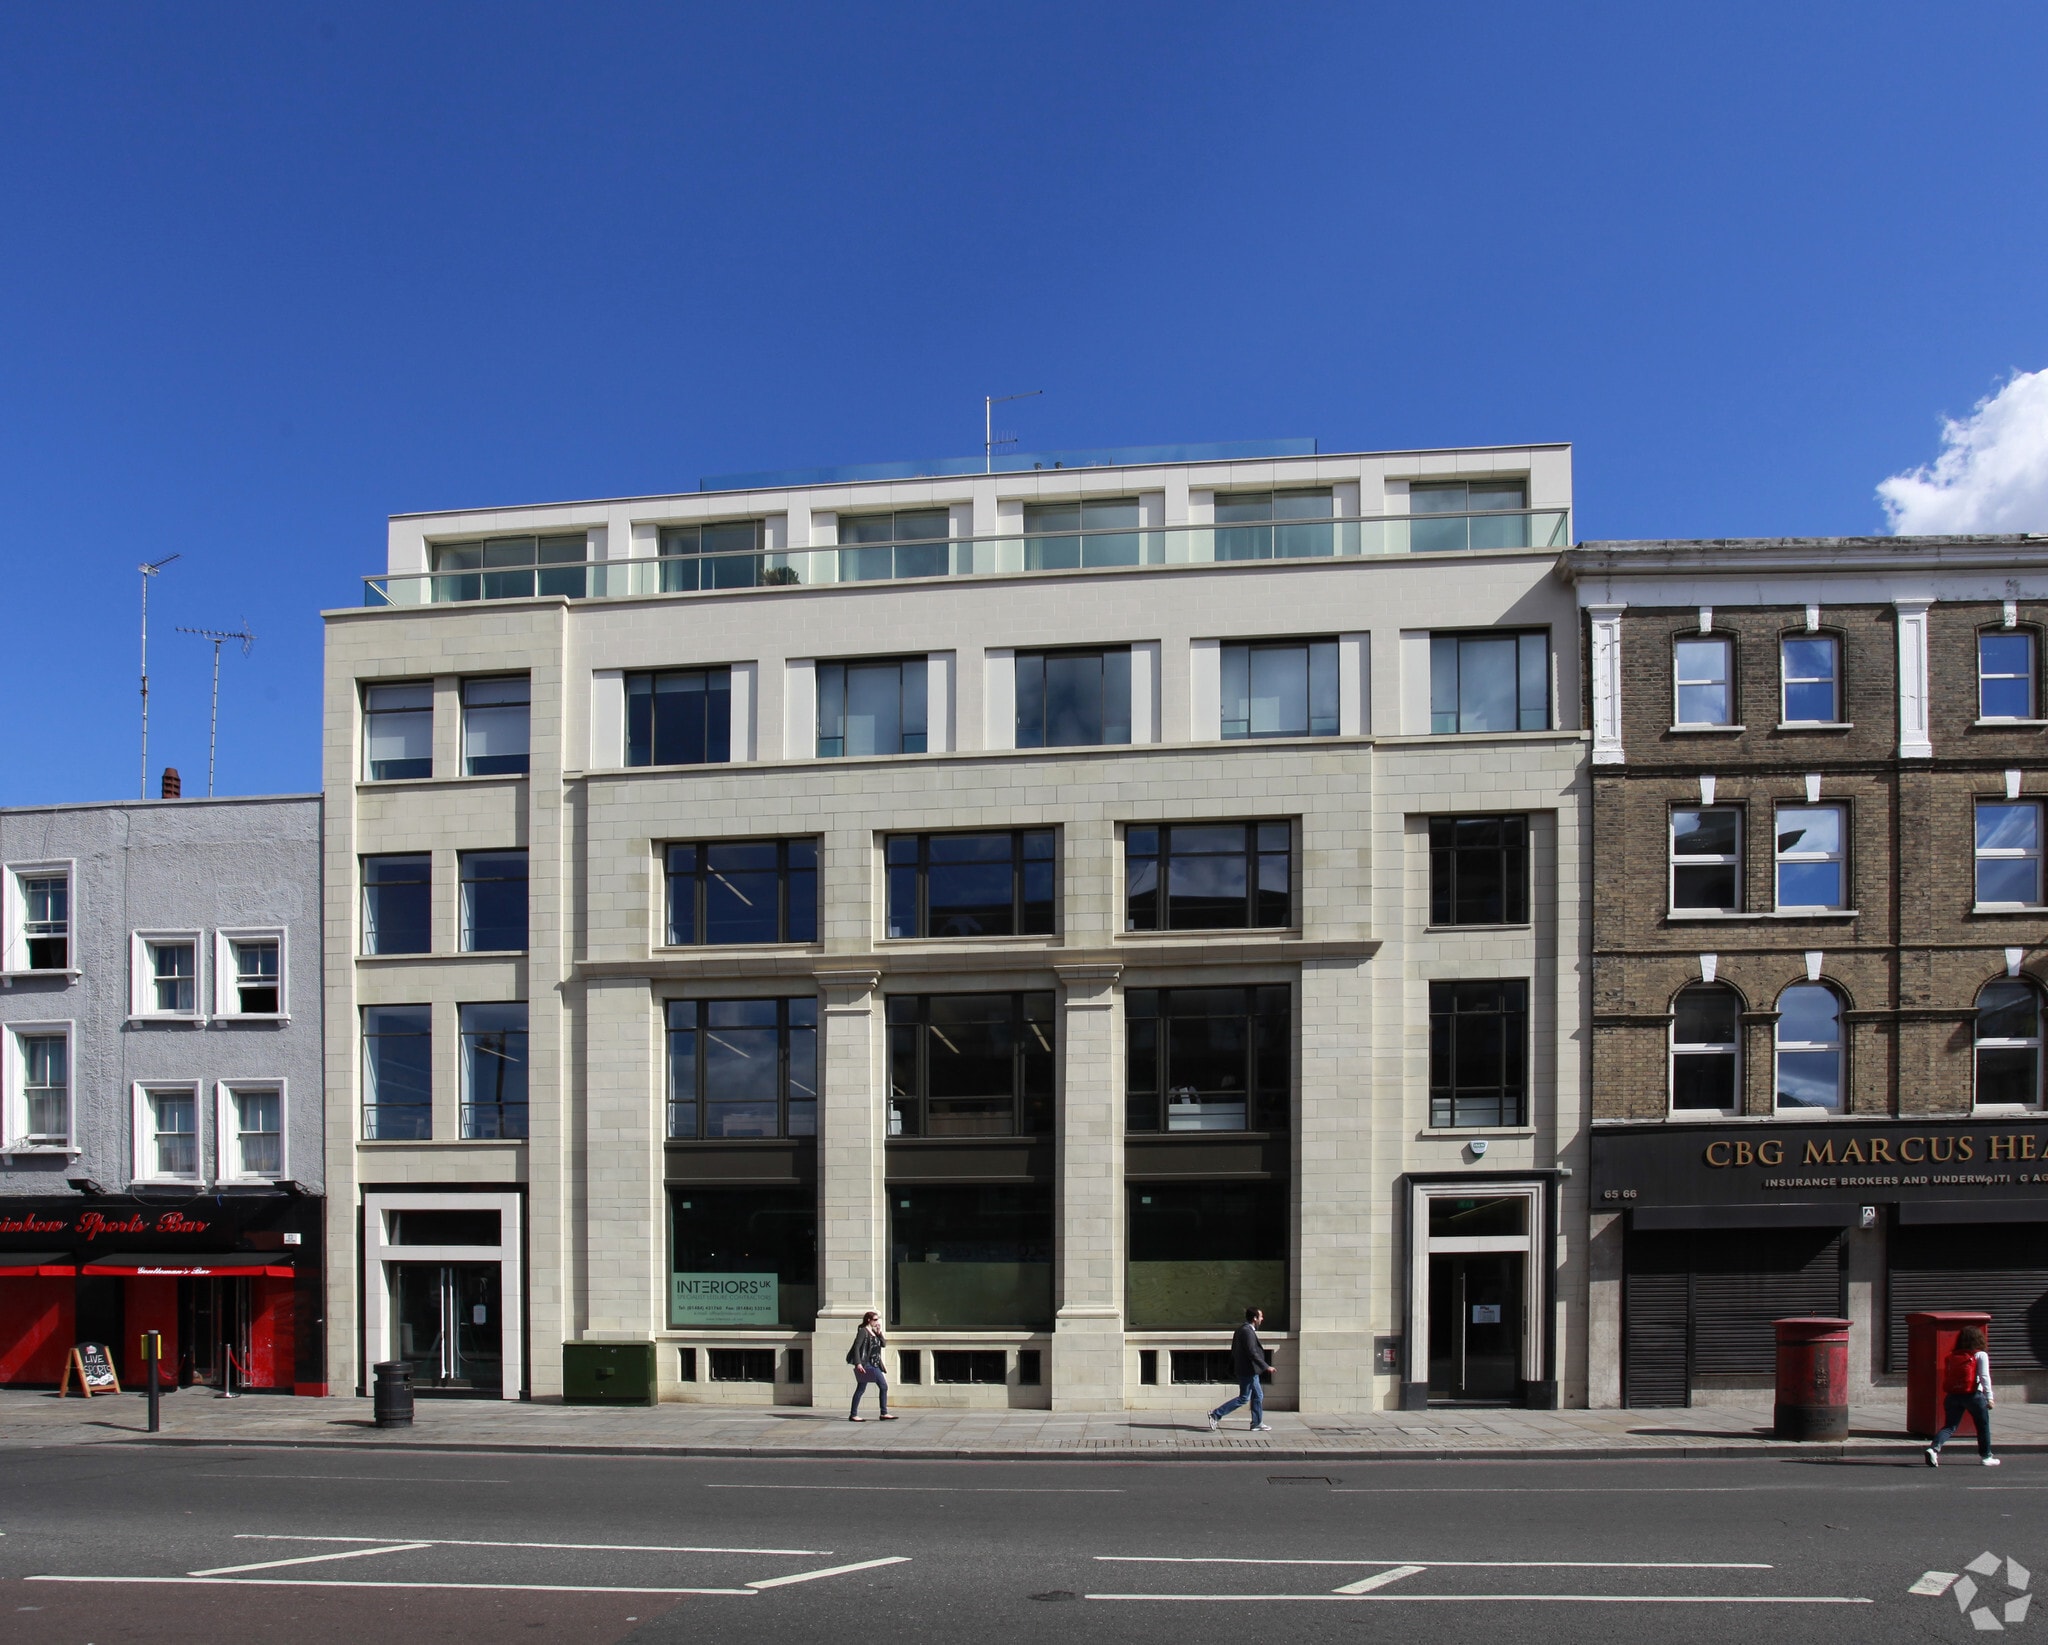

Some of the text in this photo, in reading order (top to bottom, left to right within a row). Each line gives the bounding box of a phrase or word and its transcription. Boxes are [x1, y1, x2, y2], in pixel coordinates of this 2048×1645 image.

[1706, 1140, 1784, 1166] CBG
[1803, 1135, 1974, 1164] MARCUS
[1765, 1177, 1837, 1187] INSURANCE
[1841, 1176, 1898, 1185] BROKERS
[1903, 1175, 1928, 1184] AND
[1604, 1189, 1637, 1199] 65 66
[0, 1211, 211, 1242] inbow Sports Bar
[190, 1266, 212, 1275] Bar
[677, 1280, 771, 1294] INTERIORS UK
[85, 1354, 105, 1363] LIVE
[83, 1364, 112, 1376] SPORTS
